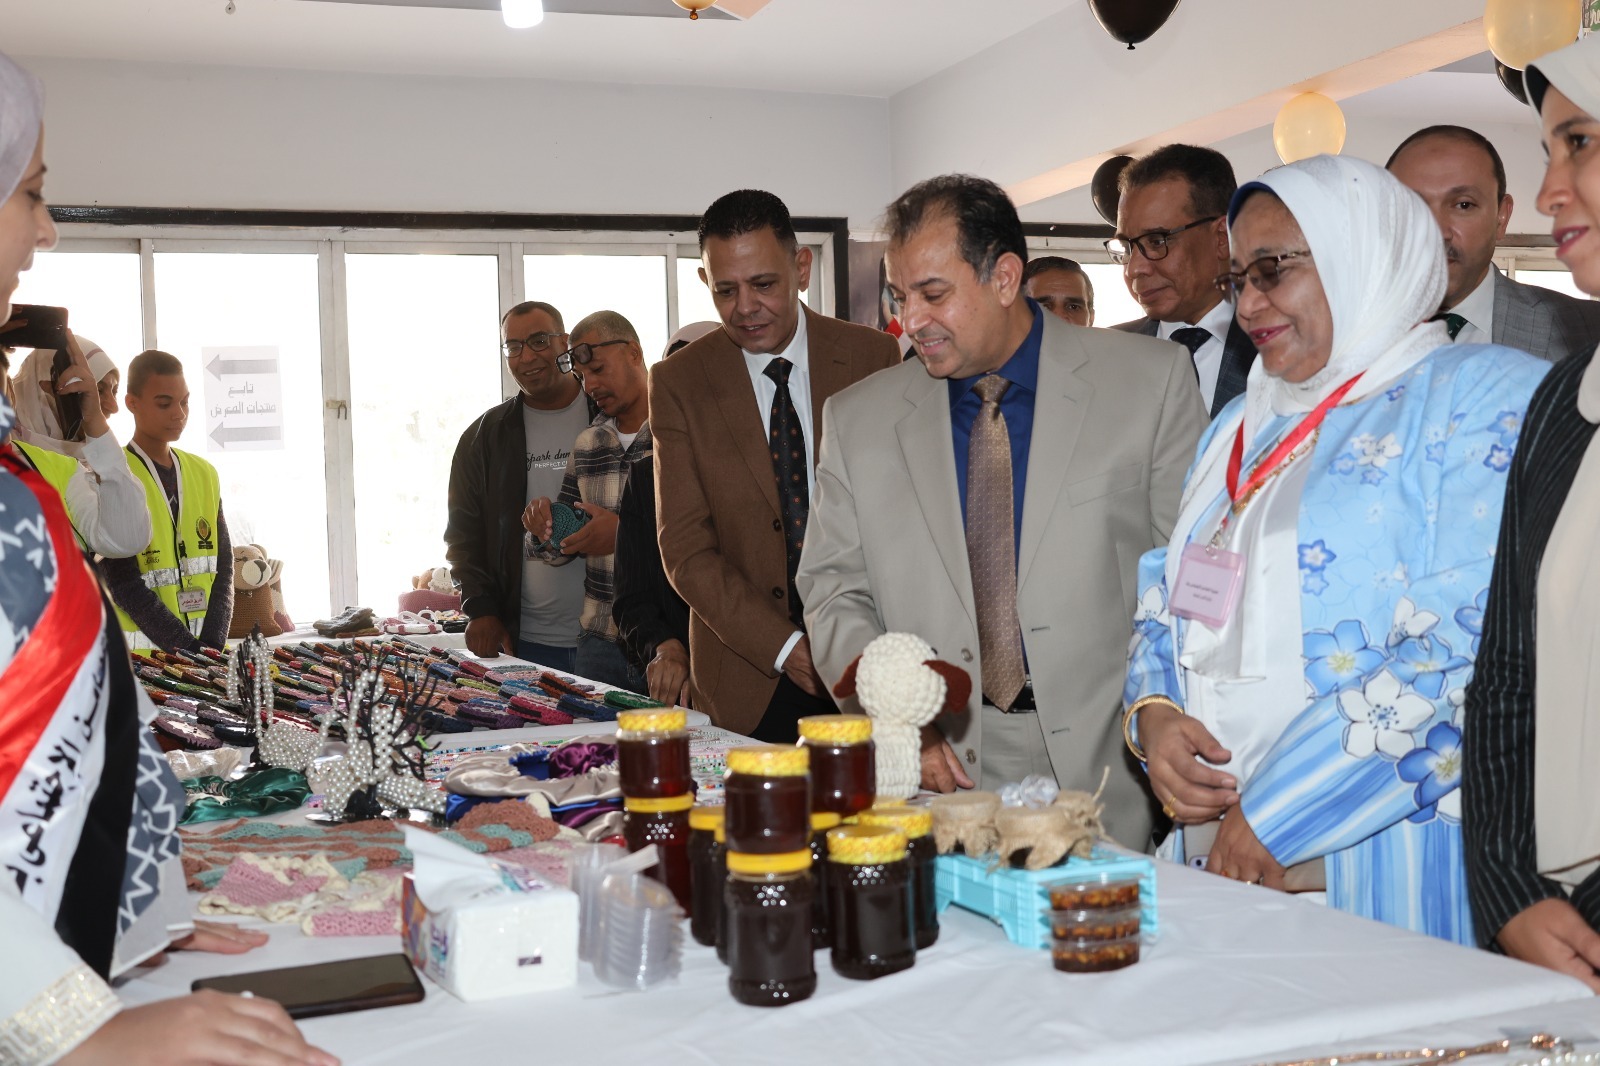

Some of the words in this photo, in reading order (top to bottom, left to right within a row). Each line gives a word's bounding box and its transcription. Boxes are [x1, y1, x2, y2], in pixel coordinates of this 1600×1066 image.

[227, 381, 254, 399] تابع
[210, 401, 244, 418] المعرض
[247, 401, 276, 416] منتجات
[534, 461, 561, 469] PERFECT
